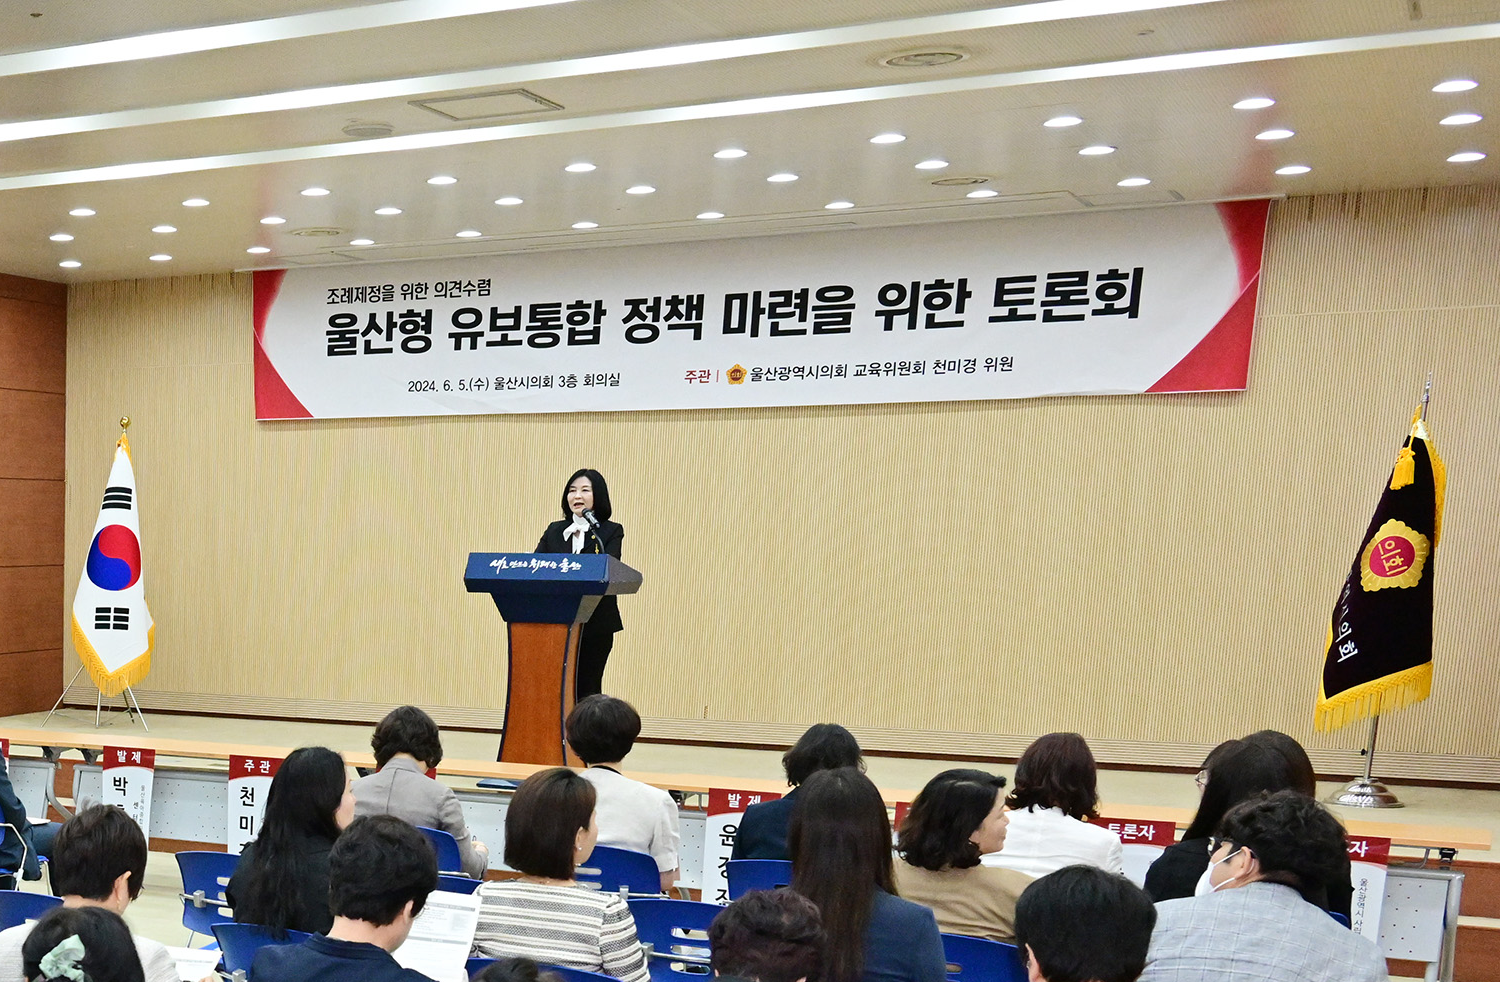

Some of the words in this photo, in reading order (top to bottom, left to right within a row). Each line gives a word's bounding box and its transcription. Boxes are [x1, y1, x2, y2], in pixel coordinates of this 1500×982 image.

[326, 284, 395, 305] 조례제정을
[400, 281, 429, 301] 위한
[434, 278, 491, 298] 의견수렴
[325, 308, 433, 357] 울산형
[448, 299, 607, 351] 유보통합
[621, 293, 705, 344] 정책
[722, 283, 856, 339] 마련을
[874, 278, 973, 332] 위한
[988, 266, 1145, 325] 토론회
[408, 379, 439, 393] 2024.
[443, 379, 454, 392] 6.
[458, 376, 490, 392] 5.(수)
[494, 374, 554, 391] 울산시의회
[558, 373, 577, 389] 3층
[584, 372, 621, 388] 회의실
[685, 369, 711, 385] 주관
[750, 363, 847, 383] 울산광역시의회
[853, 359, 927, 379] 교육위원회
[933, 357, 977, 376] 천미경
[983, 355, 1014, 374] 위원
[489, 556, 509, 574] 새로
[558, 557, 582, 573] 울산
[1378, 540, 1408, 575] 의회
[1108, 823, 1155, 840] 토론자
[1356, 878, 1368, 917] 울산광역시
